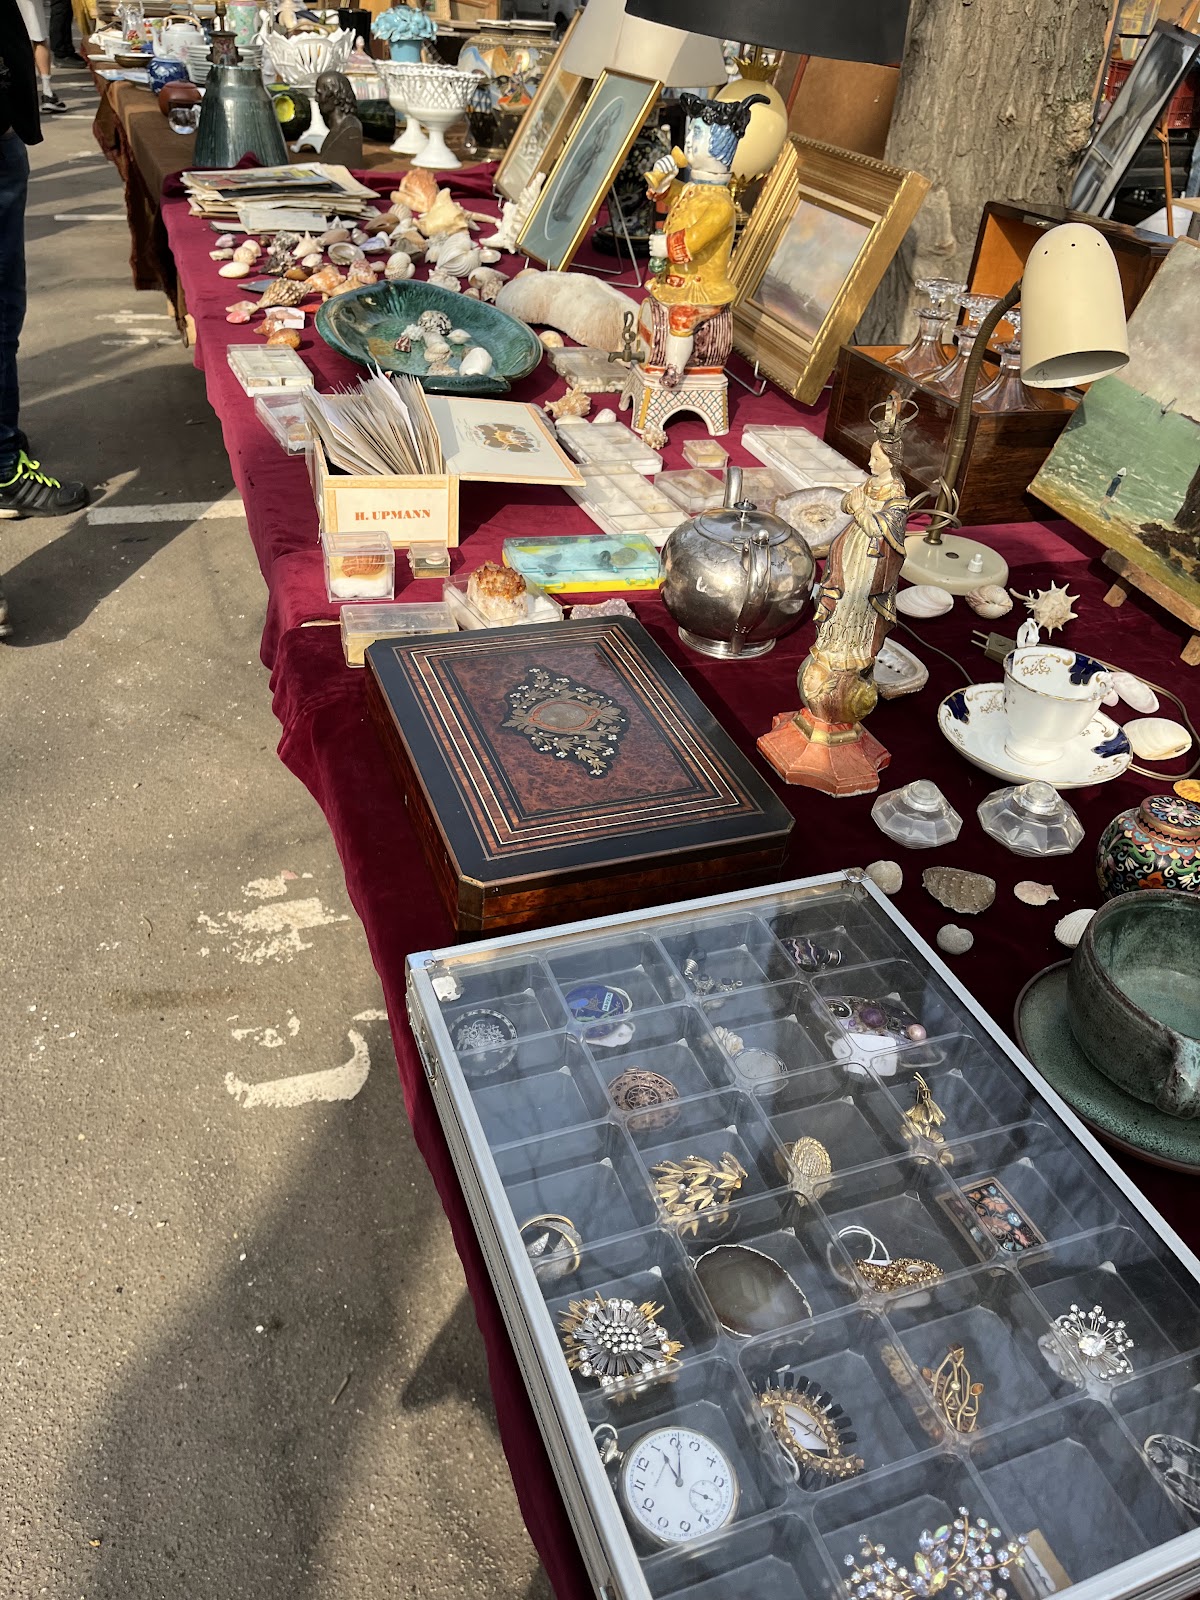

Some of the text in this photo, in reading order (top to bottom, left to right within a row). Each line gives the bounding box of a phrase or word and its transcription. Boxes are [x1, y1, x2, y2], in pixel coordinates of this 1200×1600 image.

[355, 509, 430, 520] H. UPMANN
[669, 1437, 682, 1450] 2
[689, 1441, 700, 1452] 3
[637, 1458, 650, 1472] 12
[706, 1456, 716, 1468] 4
[634, 1480, 646, 1490] 11
[714, 1476, 724, 1488] 5
[642, 1497, 655, 1513] 10
[698, 1514, 710, 1525] 7
[680, 1520, 691, 1532] 8
